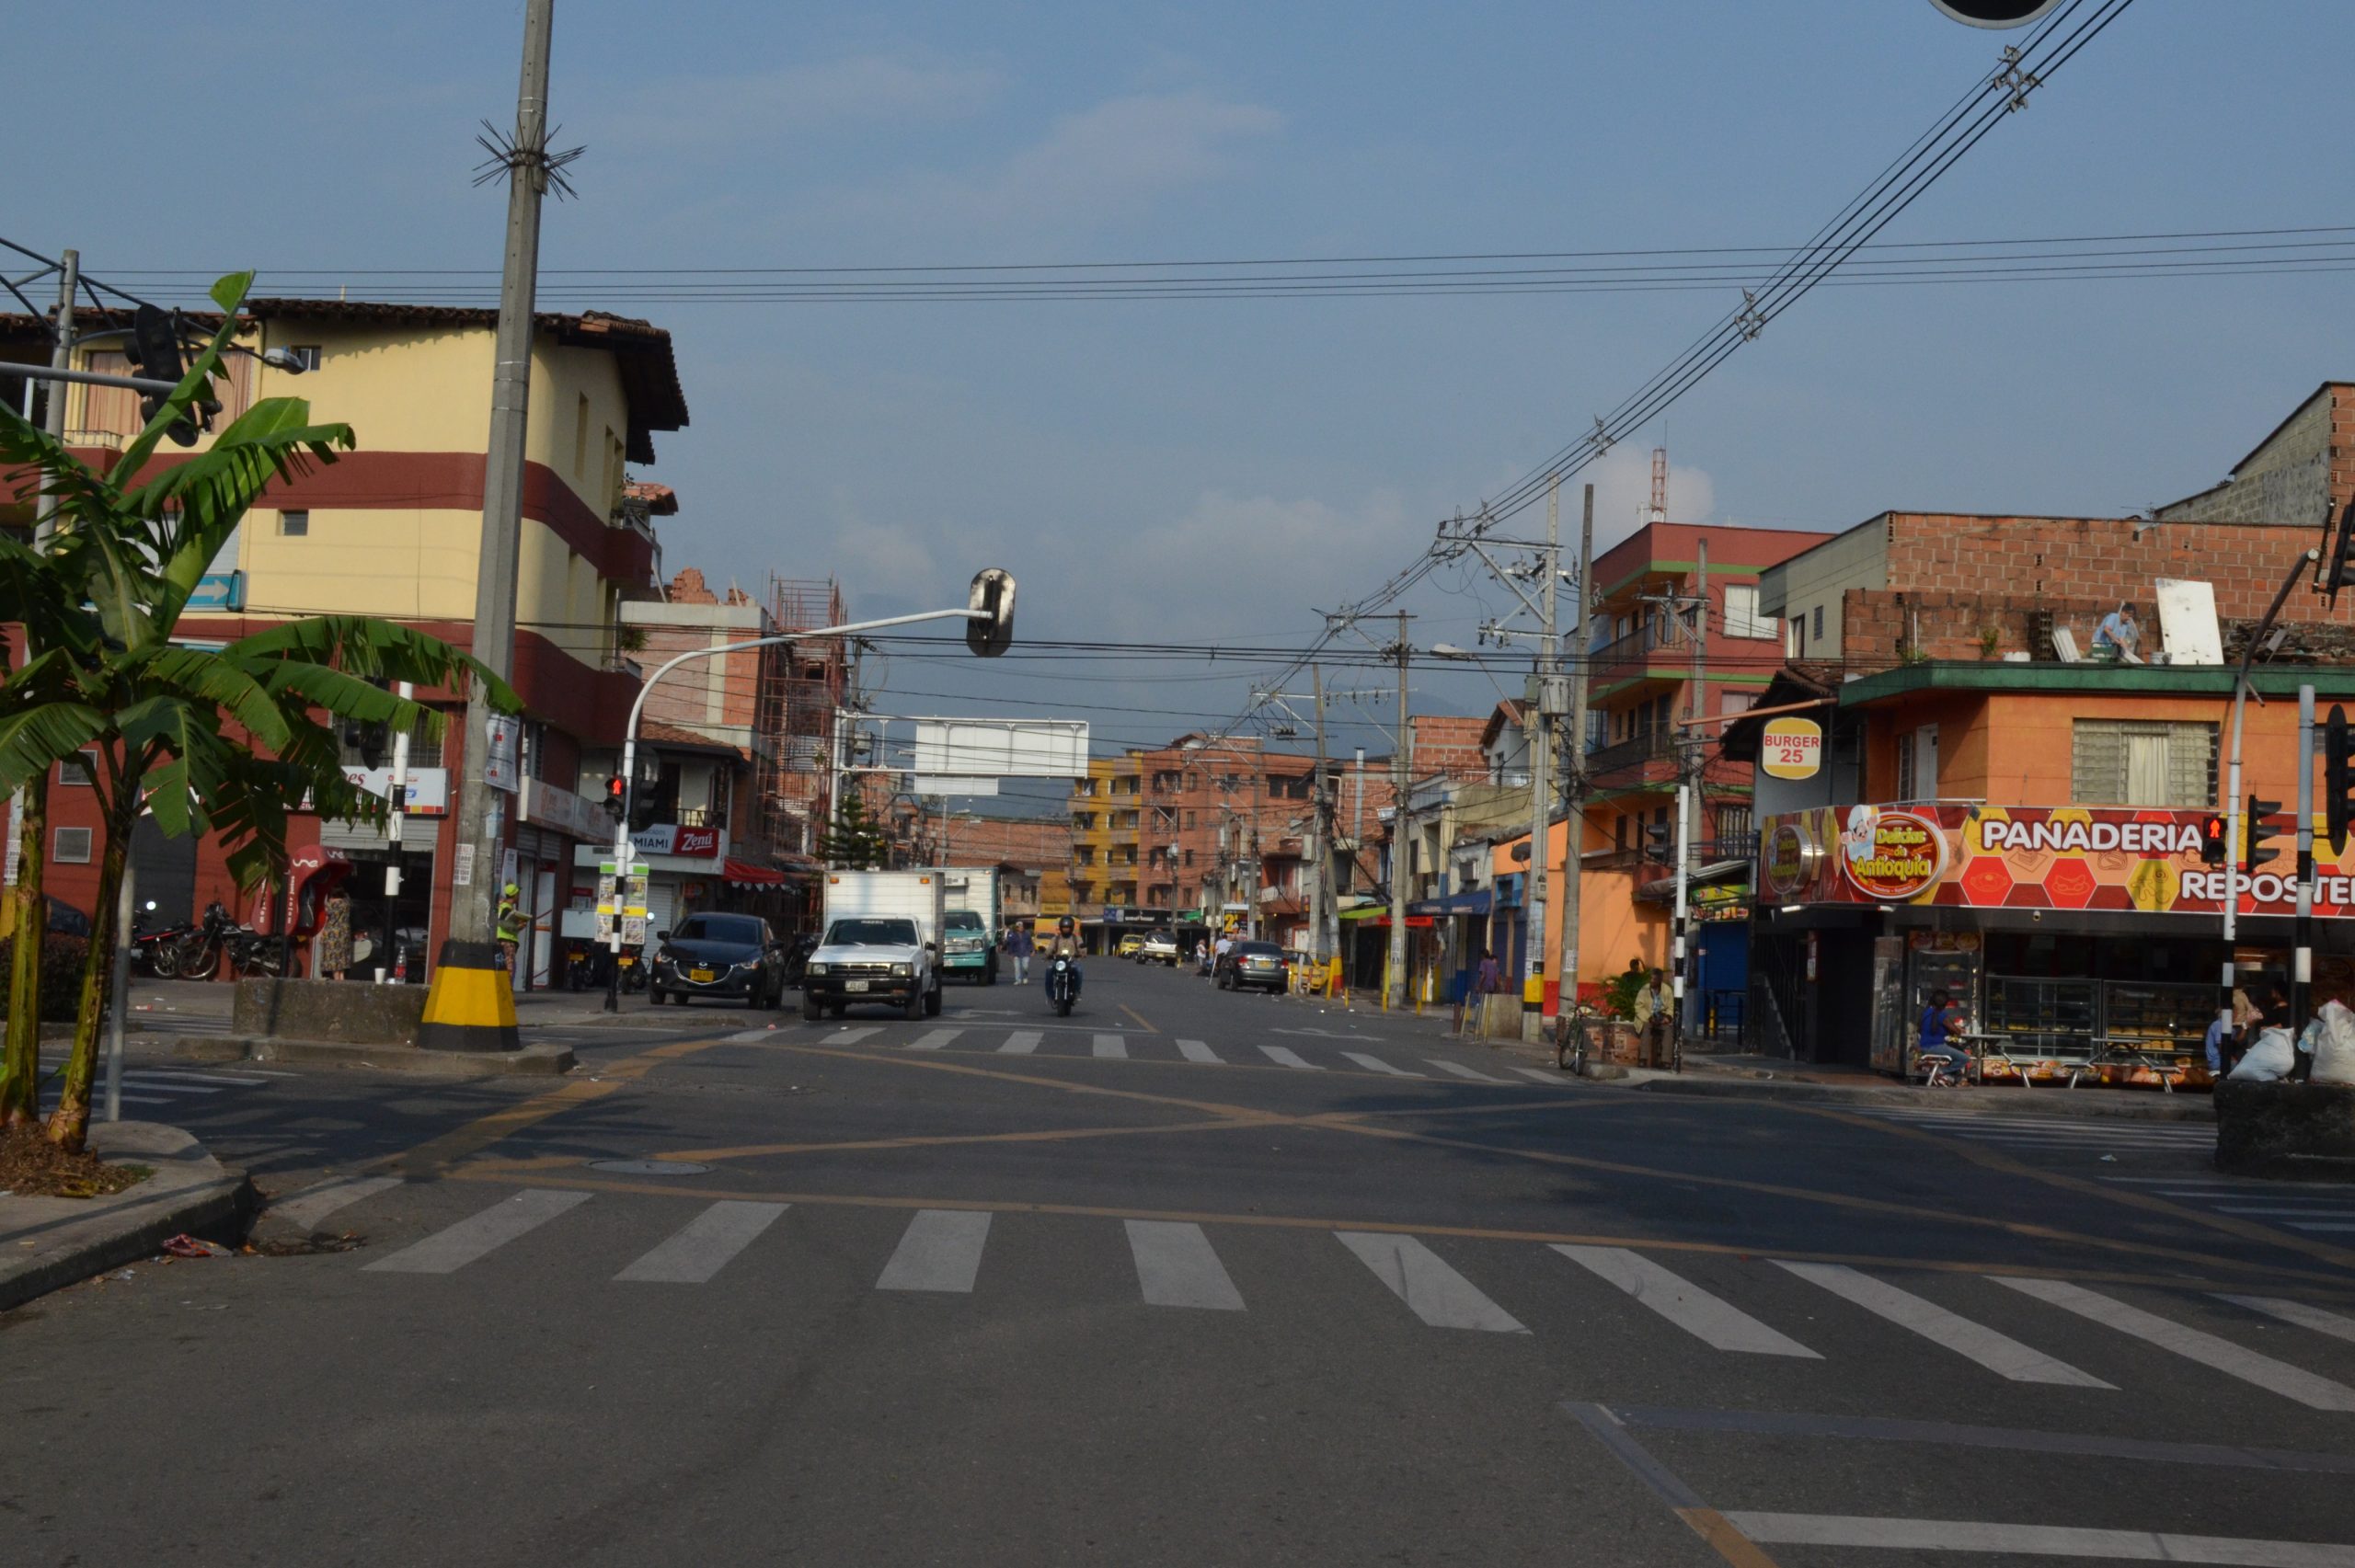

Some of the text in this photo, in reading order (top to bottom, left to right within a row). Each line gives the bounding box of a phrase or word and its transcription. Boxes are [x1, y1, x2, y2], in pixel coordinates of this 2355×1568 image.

[1764, 736, 1820, 748] BURGER
[1780, 750, 1803, 763] 25
[634, 837, 669, 849] MIAMI
[682, 832, 715, 851] Zenú
[1876, 827, 1927, 844] Delicias
[1983, 821, 2202, 852] PANADERIA
[1894, 844, 1908, 857] de
[1854, 853, 1932, 881] Antioquia
